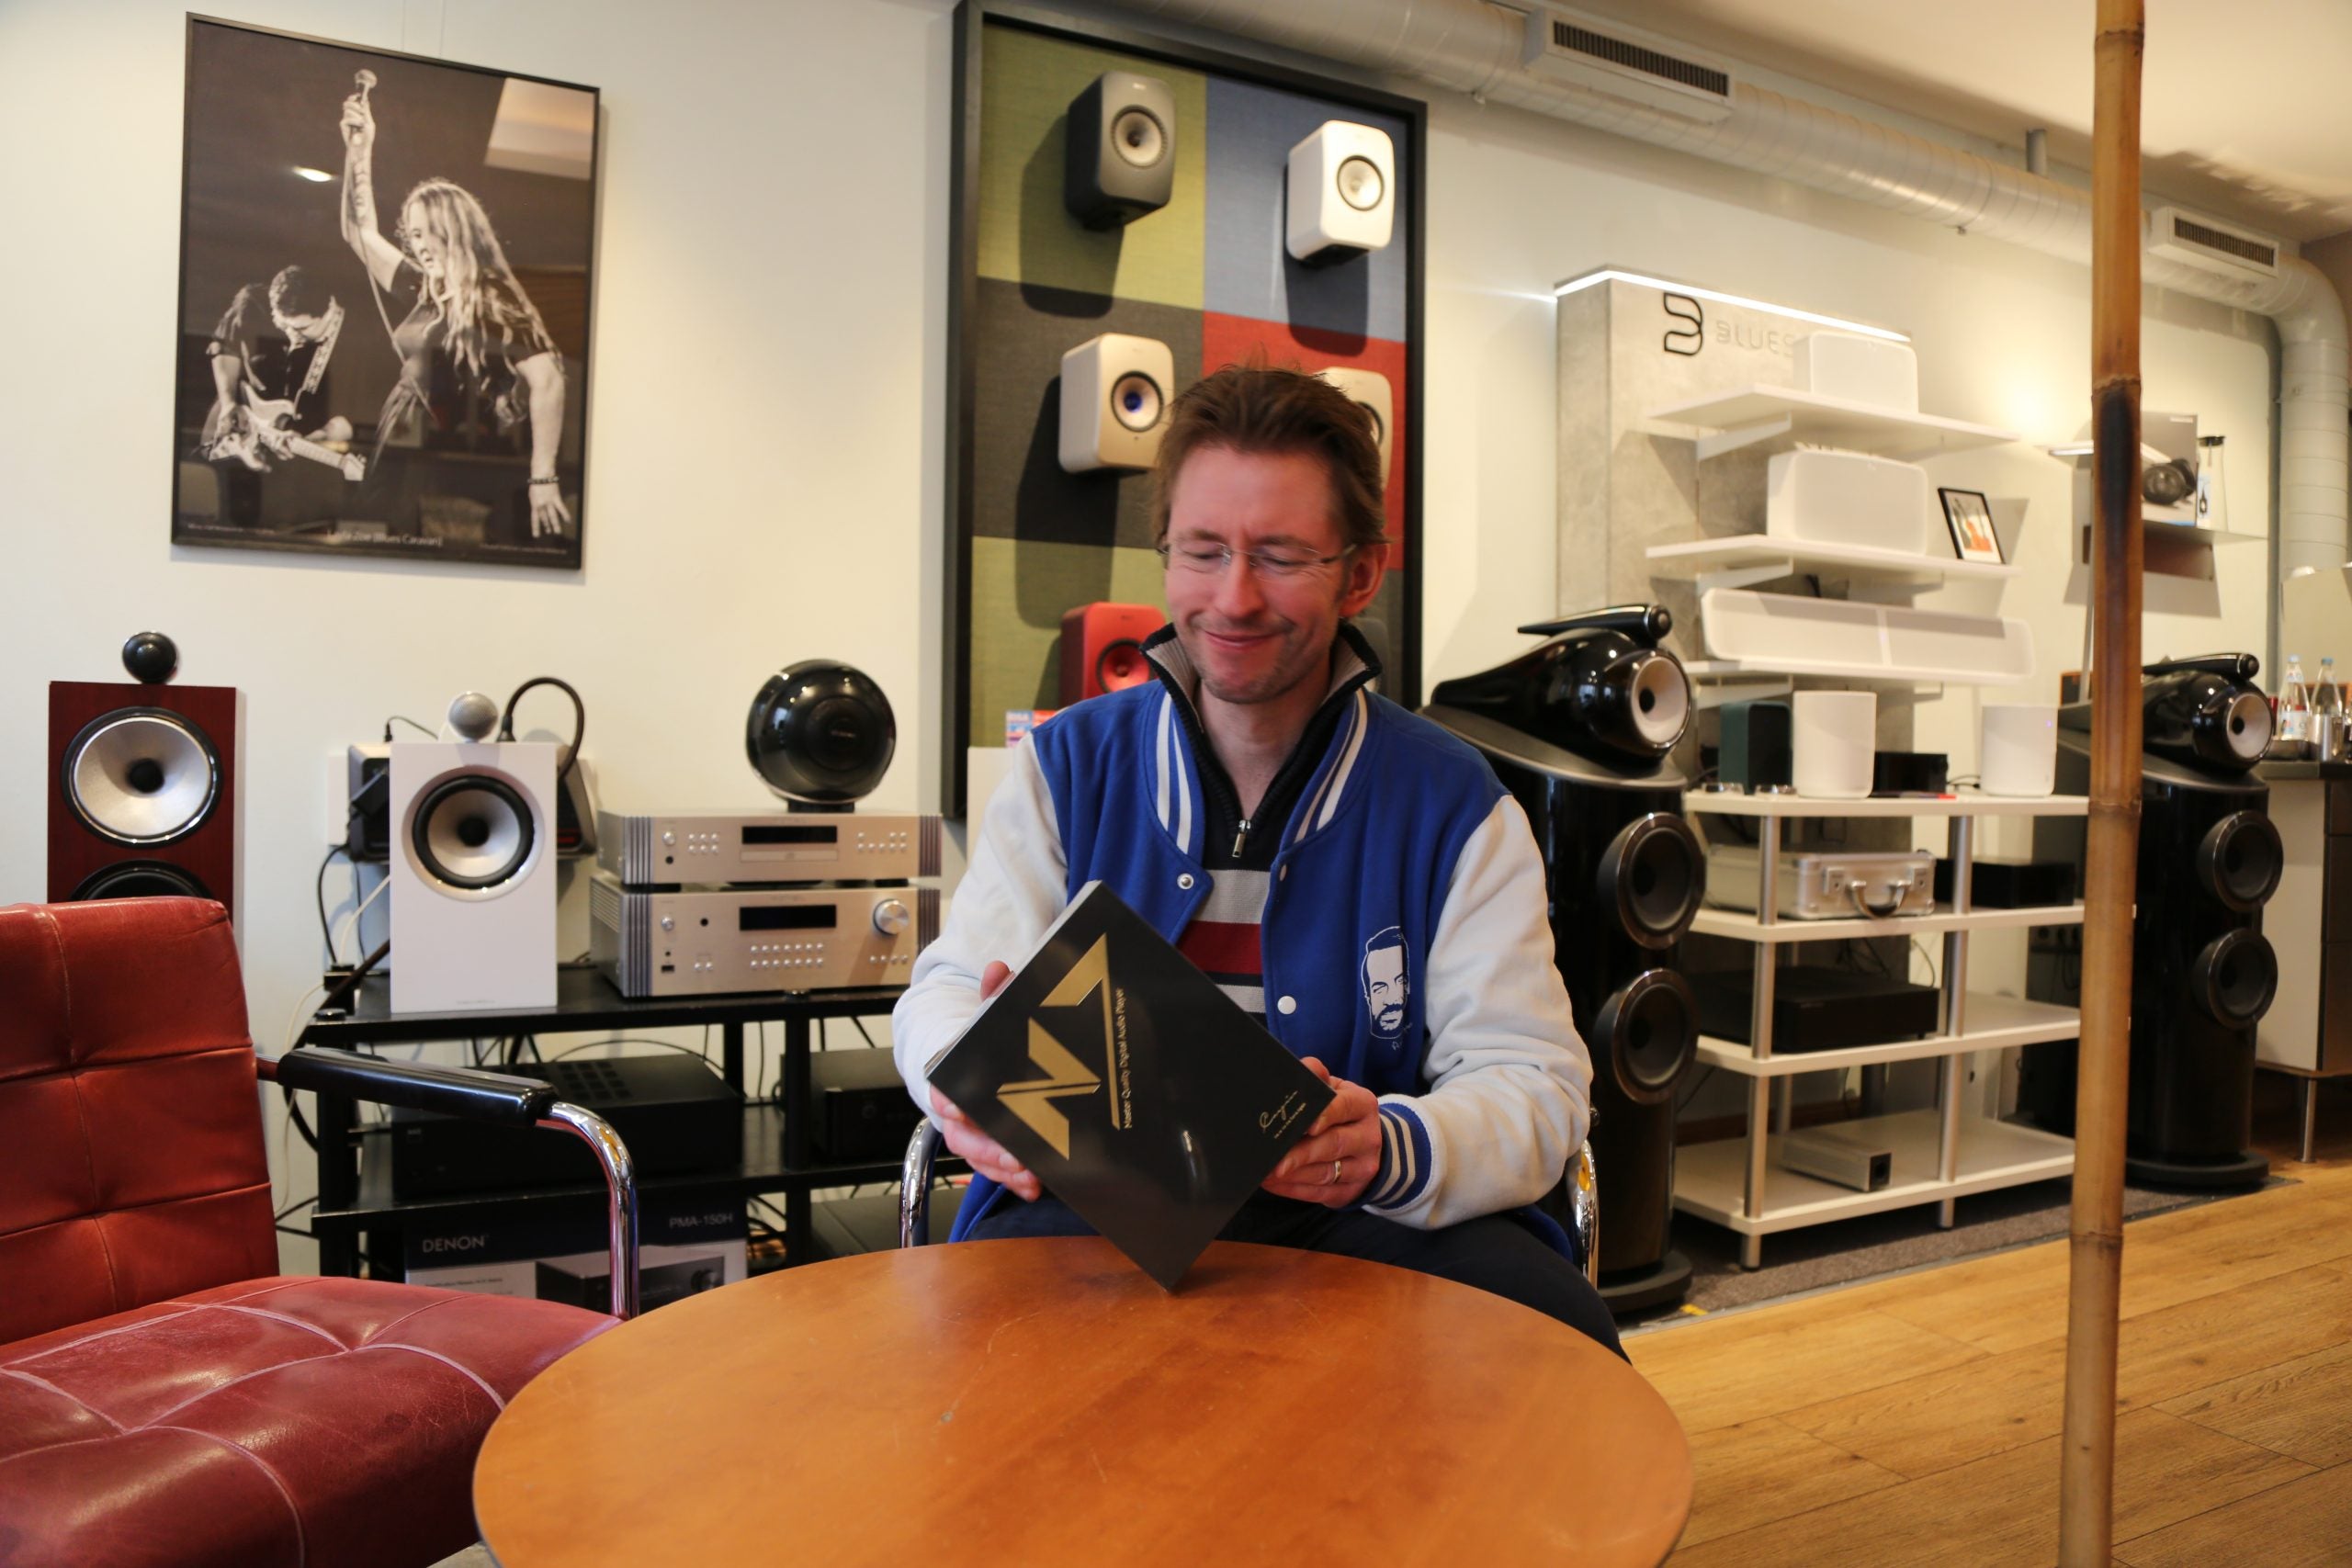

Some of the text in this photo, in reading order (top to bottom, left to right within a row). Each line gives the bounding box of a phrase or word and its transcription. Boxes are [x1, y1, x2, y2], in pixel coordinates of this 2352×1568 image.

[1116, 1014, 1126, 1038] Audio
[1119, 1040, 1130, 1067] Digital
[1121, 1069, 1131, 1099] Quality
[422, 1235, 486, 1254] DENON
